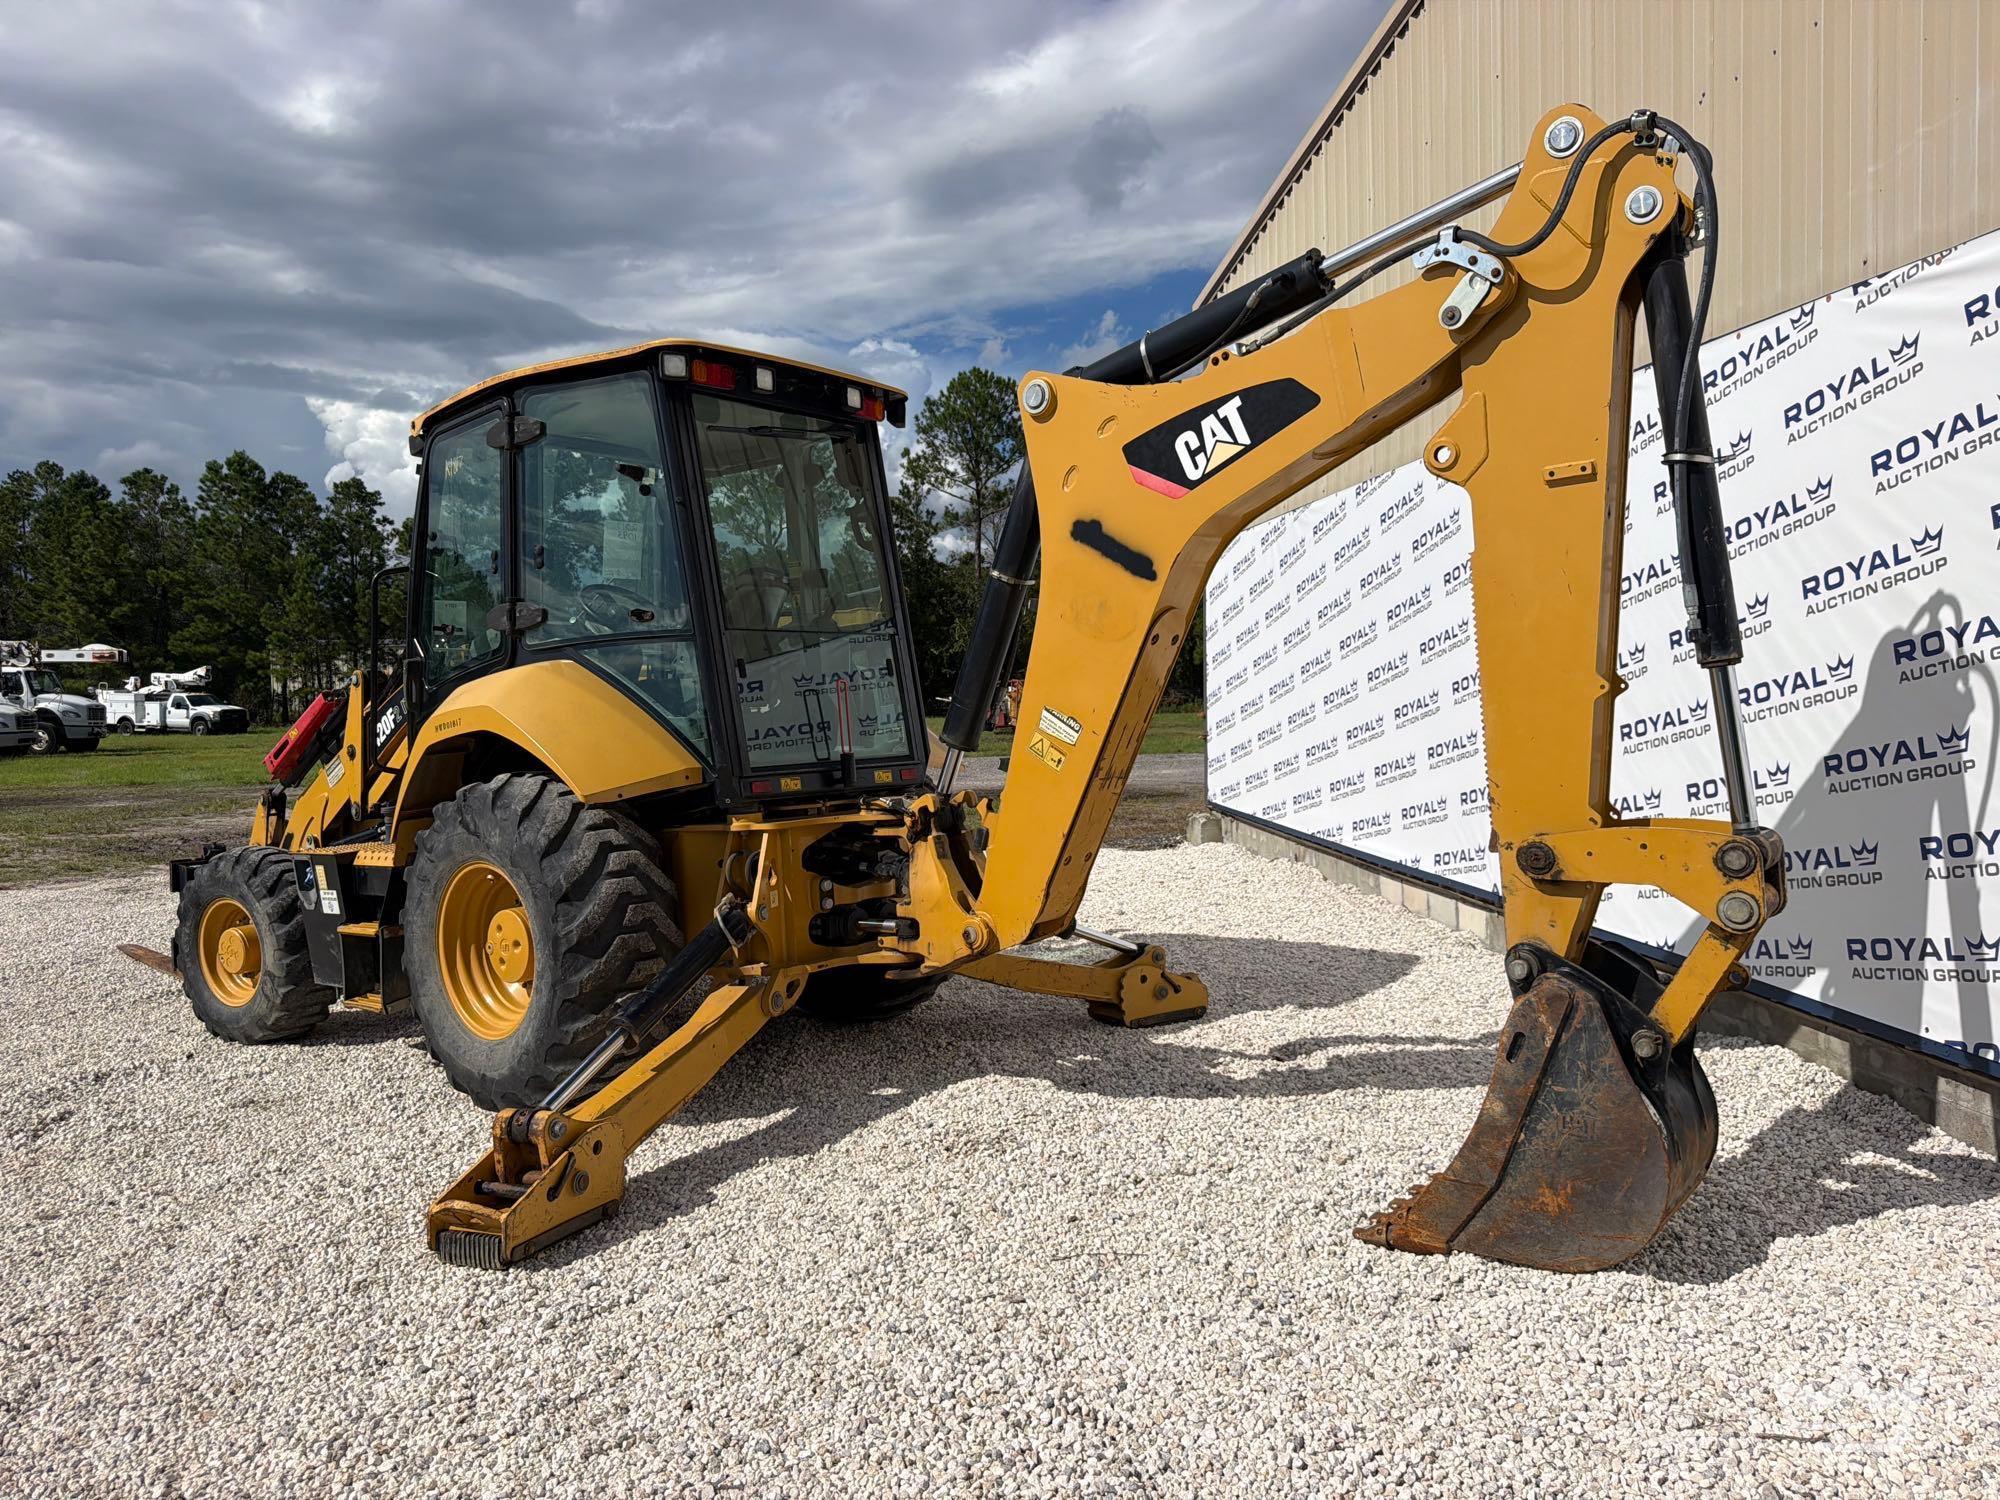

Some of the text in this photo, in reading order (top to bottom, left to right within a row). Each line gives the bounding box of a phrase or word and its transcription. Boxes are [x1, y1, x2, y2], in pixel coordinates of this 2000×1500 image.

[1703, 326, 1790, 393] ROYAL
[1706, 328, 1818, 407] AUCTION GROUP
[1783, 357, 1889, 430] ROYAL
[1787, 362, 1924, 446] AUCTION GROUP
[1174, 395, 1251, 481] CAT
[1640, 429, 1663, 450] GRO
[1871, 402, 1998, 477] ROYAL
[1718, 455, 1755, 483] ROUP
[1875, 447, 1959, 496] AUCTION
[1380, 491, 1414, 526] ROYAL
[1313, 507, 1339, 537] ROYAL
[1728, 503, 1836, 560] UCTION GROUP
[1413, 518, 1450, 553] ROYAL
[1414, 525, 1462, 564] AUCTION GROUP
[1334, 534, 1362, 564] ROYAL
[1296, 569, 1320, 595] ROYAL
[1360, 561, 1391, 591] ROYAL
[1443, 559, 1470, 587] ROY
[1621, 559, 1672, 595] OYAL
[1802, 543, 1911, 600] ROYAL
[1622, 588, 1652, 610] CTION
[1806, 557, 1948, 617] AUCTION GROUP
[1318, 595, 1344, 621] ROYAL
[1388, 592, 1422, 622] ROYAL
[1389, 600, 1432, 632] AUCTION GROUP
[1340, 626, 1368, 652] ROYAL
[1420, 626, 1459, 656] ROYAL
[1422, 635, 1470, 666] AUCTION GROUP
[1893, 616, 2000, 665] ROYA
[1301, 654, 1325, 676] ROYAL
[1368, 658, 1399, 684] ROYAL
[1621, 666, 1648, 683] ROUP
[1899, 650, 1985, 684] AUCTION
[1324, 684, 1350, 707] ROYAL
[1452, 672, 1478, 695] ROY
[1803, 684, 1858, 708] GROUP
[1395, 695, 1430, 720] ROYAL
[1396, 706, 1440, 730] AUCTION GROUP
[1347, 720, 1376, 742] ROYAL
[1620, 708, 1689, 742] ROYAL
[1306, 740, 1331, 759] ROYAL
[1428, 736, 1467, 760] ROYAL
[1622, 724, 1711, 755] AUCTION GROUP
[1375, 757, 1407, 778] ROYAL
[1430, 748, 1479, 770] AUCTION GROUP
[1823, 736, 1938, 777] ROYAL
[1330, 775, 1357, 794] ROYAL
[1828, 759, 1976, 795] AUCTION GROUP
[1292, 790, 1315, 806] ROYAL
[1460, 786, 1486, 806] ROY
[1755, 790, 1794, 807] ROUP
[1352, 815, 1382, 833] ROYAL
[1402, 801, 1438, 821] ROYAL
[1404, 814, 1449, 831] AUCTION GROUP
[1434, 849, 1474, 867] ROYAL
[1919, 830, 2000, 861] ROY
[1463, 863, 1487, 874] GROUP
[1787, 872, 1882, 890] TION GROUP
[1924, 862, 2000, 881] AUCTIO
[1846, 937, 1965, 961] ROYAL
[1765, 965, 1815, 978] GROUP
[1852, 967, 1929, 982] AUCTION
